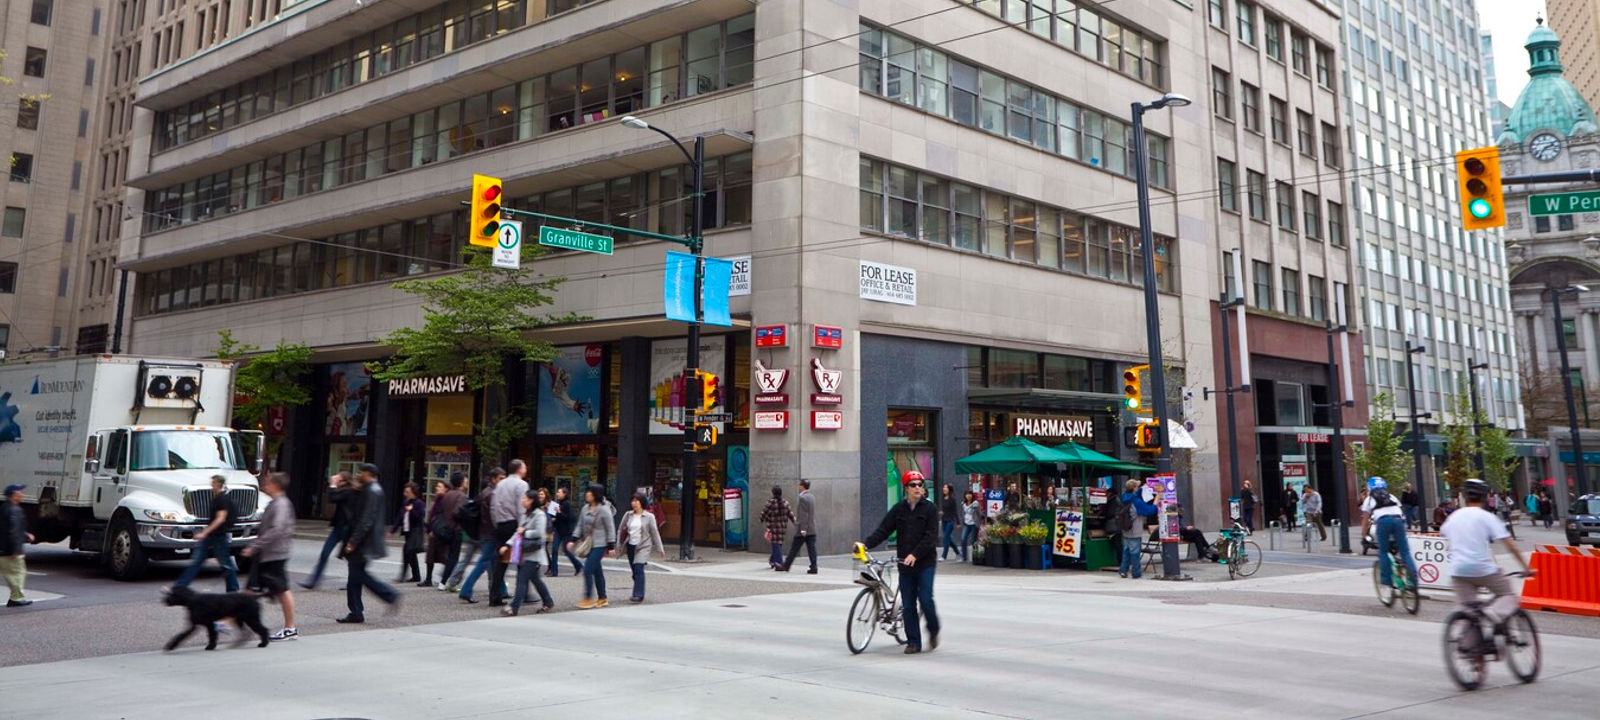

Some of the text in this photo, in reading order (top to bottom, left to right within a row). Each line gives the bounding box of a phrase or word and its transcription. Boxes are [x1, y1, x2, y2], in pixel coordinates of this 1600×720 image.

[1545, 197, 1560, 211] W
[546, 230, 607, 251] Granville St
[861, 264, 914, 285] FOR LEASE
[861, 278, 914, 294] OFFICE & RETAIL
[388, 375, 465, 395] PHARMASAVE
[1016, 418, 1093, 437] PHARMASAVE
[1297, 433, 1329, 443] FOR LEASE
[1056, 510, 1082, 526] Tulips
[1056, 522, 1067, 538] 3
[1424, 540, 1449, 551] RO
